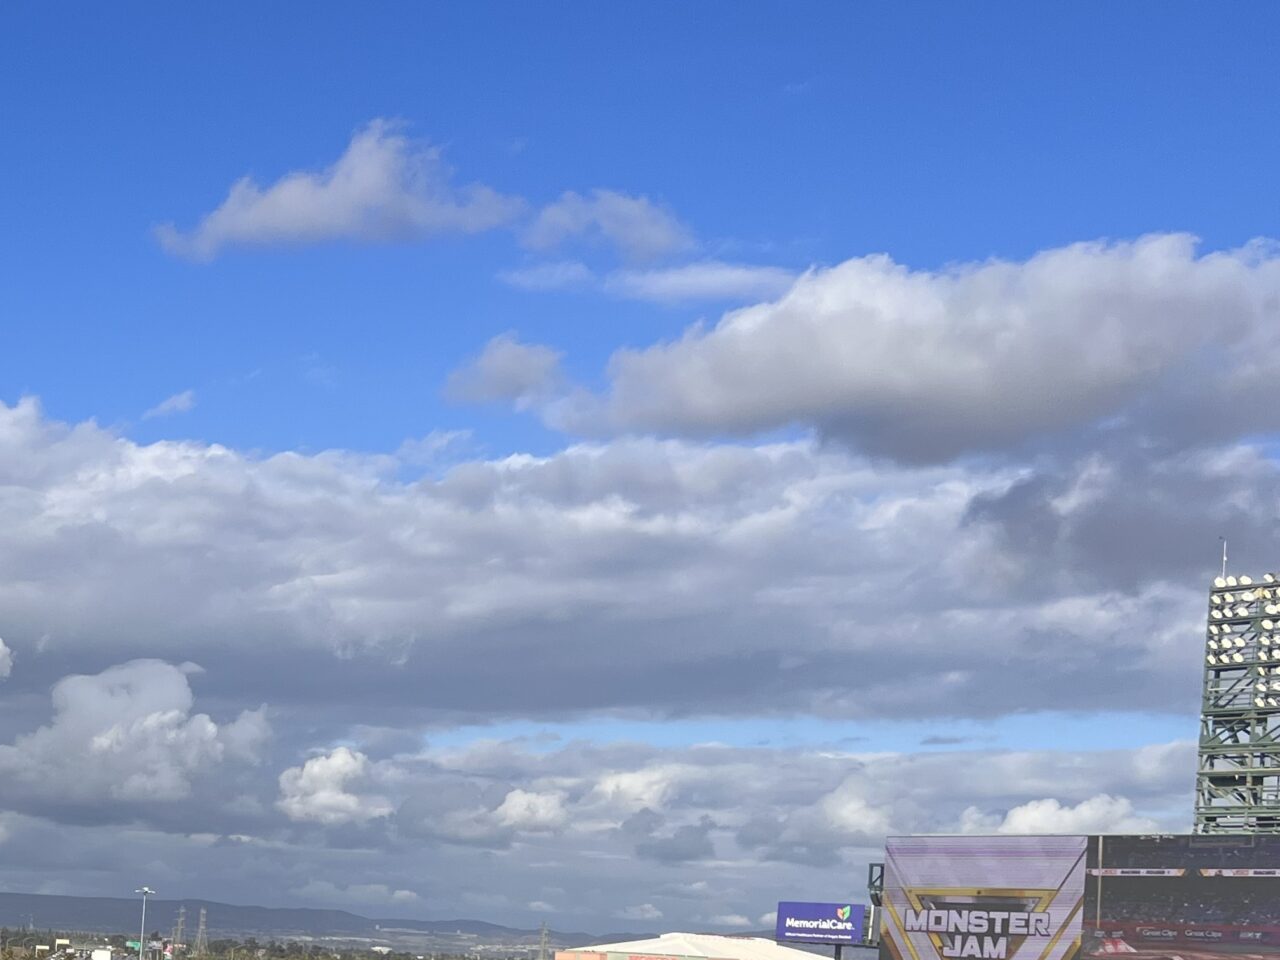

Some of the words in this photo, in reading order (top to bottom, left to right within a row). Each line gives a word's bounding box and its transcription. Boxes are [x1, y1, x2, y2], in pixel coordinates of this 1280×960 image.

[786, 917, 854, 931] MemorialCare
[904, 909, 1051, 937] MONSTER
[942, 934, 1008, 959] JAM
